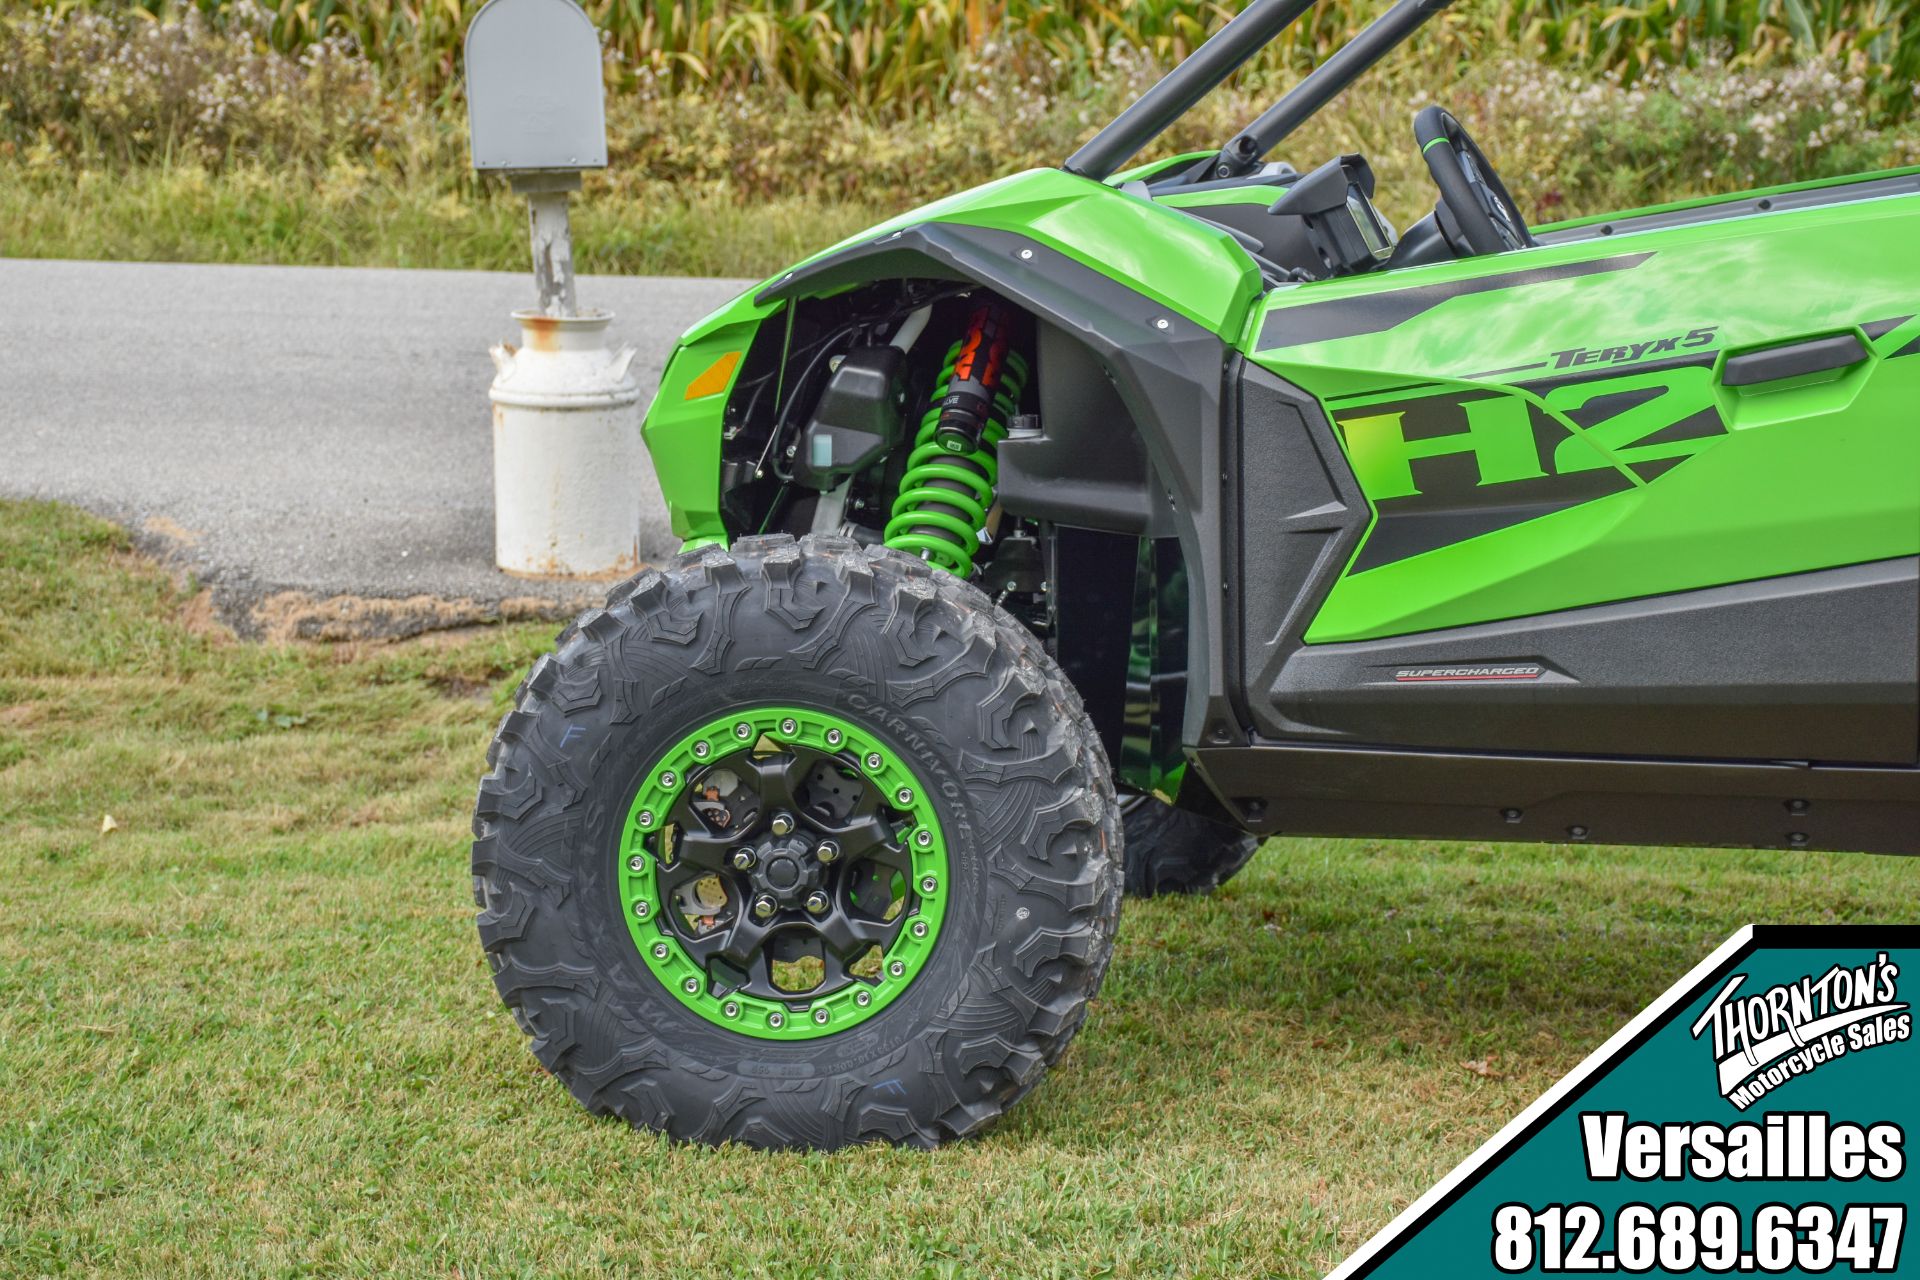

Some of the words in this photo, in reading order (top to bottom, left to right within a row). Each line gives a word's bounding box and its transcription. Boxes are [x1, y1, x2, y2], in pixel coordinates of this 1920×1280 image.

[1337, 366, 1729, 500] H2
[1395, 667, 1540, 677] SUPERCHARGED
[849, 694, 972, 840] CARNIVORE
